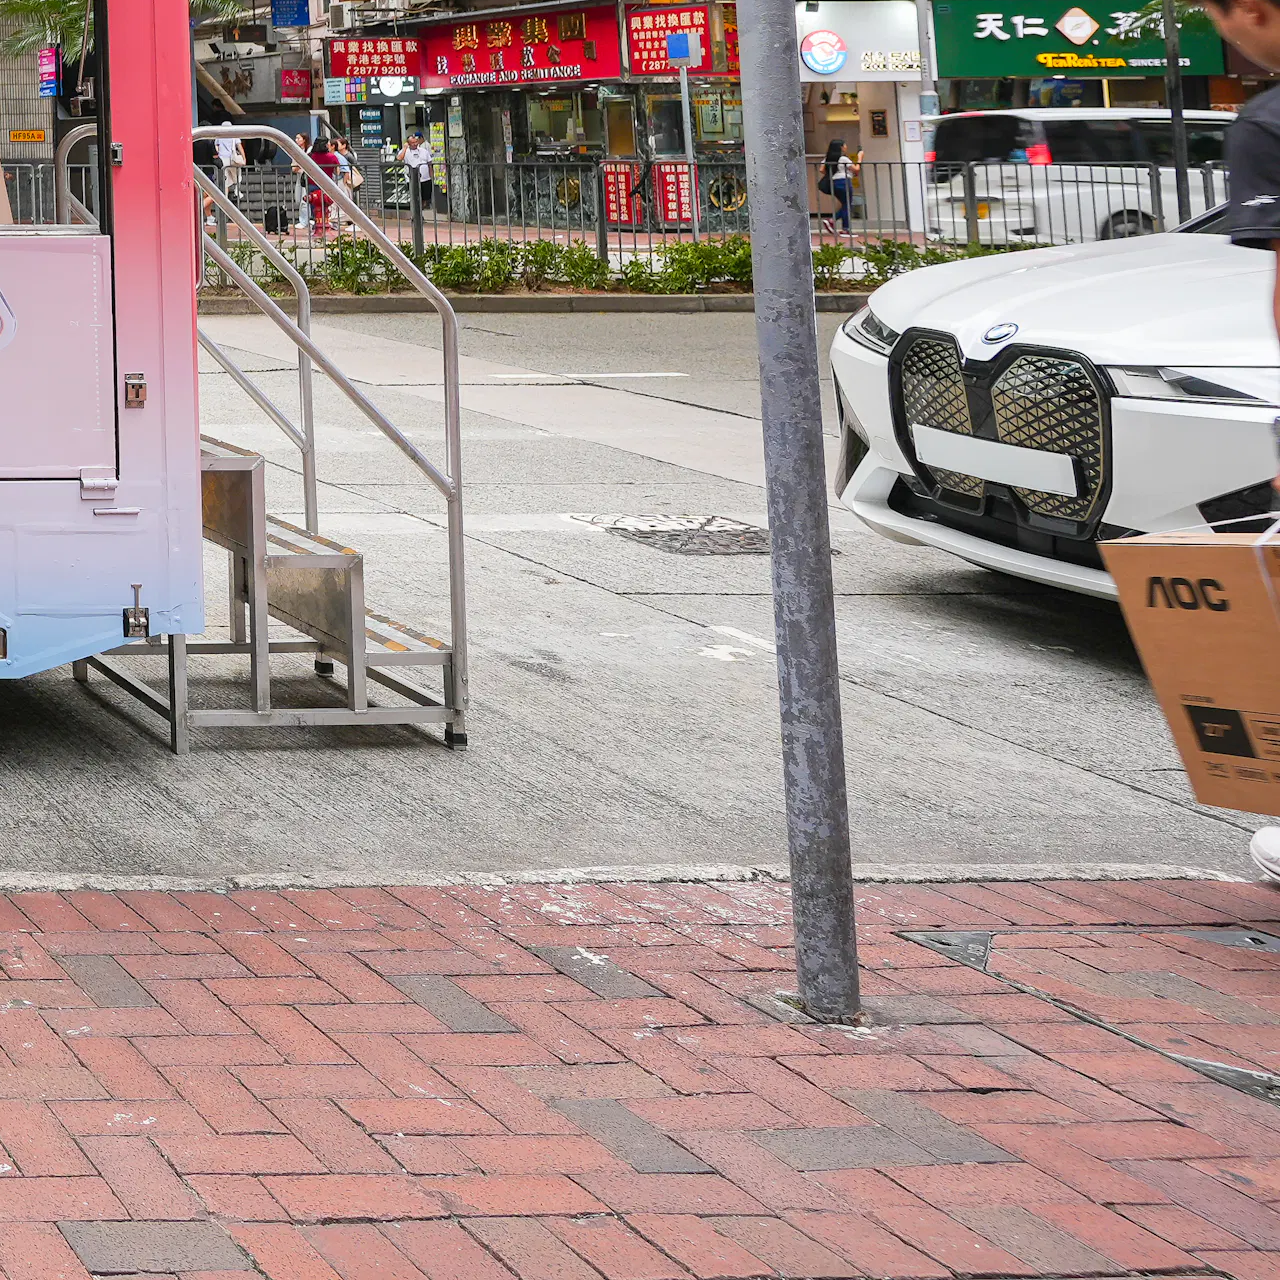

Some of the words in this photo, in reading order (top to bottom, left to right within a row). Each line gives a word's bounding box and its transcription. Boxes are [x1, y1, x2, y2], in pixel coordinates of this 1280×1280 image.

[631, 11, 705, 30] 興業找換匯款
[973, 13, 1049, 41] 天仁
[333, 41, 418, 54] 興業找換匯款
[347, 54, 406, 65] 香港老字號
[1128, 58, 1161, 67] SINCE
[353, 66, 380, 75] 2877
[381, 66, 407, 75] 9208
[450, 71, 496, 85] EXCHANGE
[498, 70, 518, 82] AND
[520, 64, 581, 81] REMITTANCE
[12, 132, 36, 140] HF95A
[1146, 576, 1232, 612] AOC
